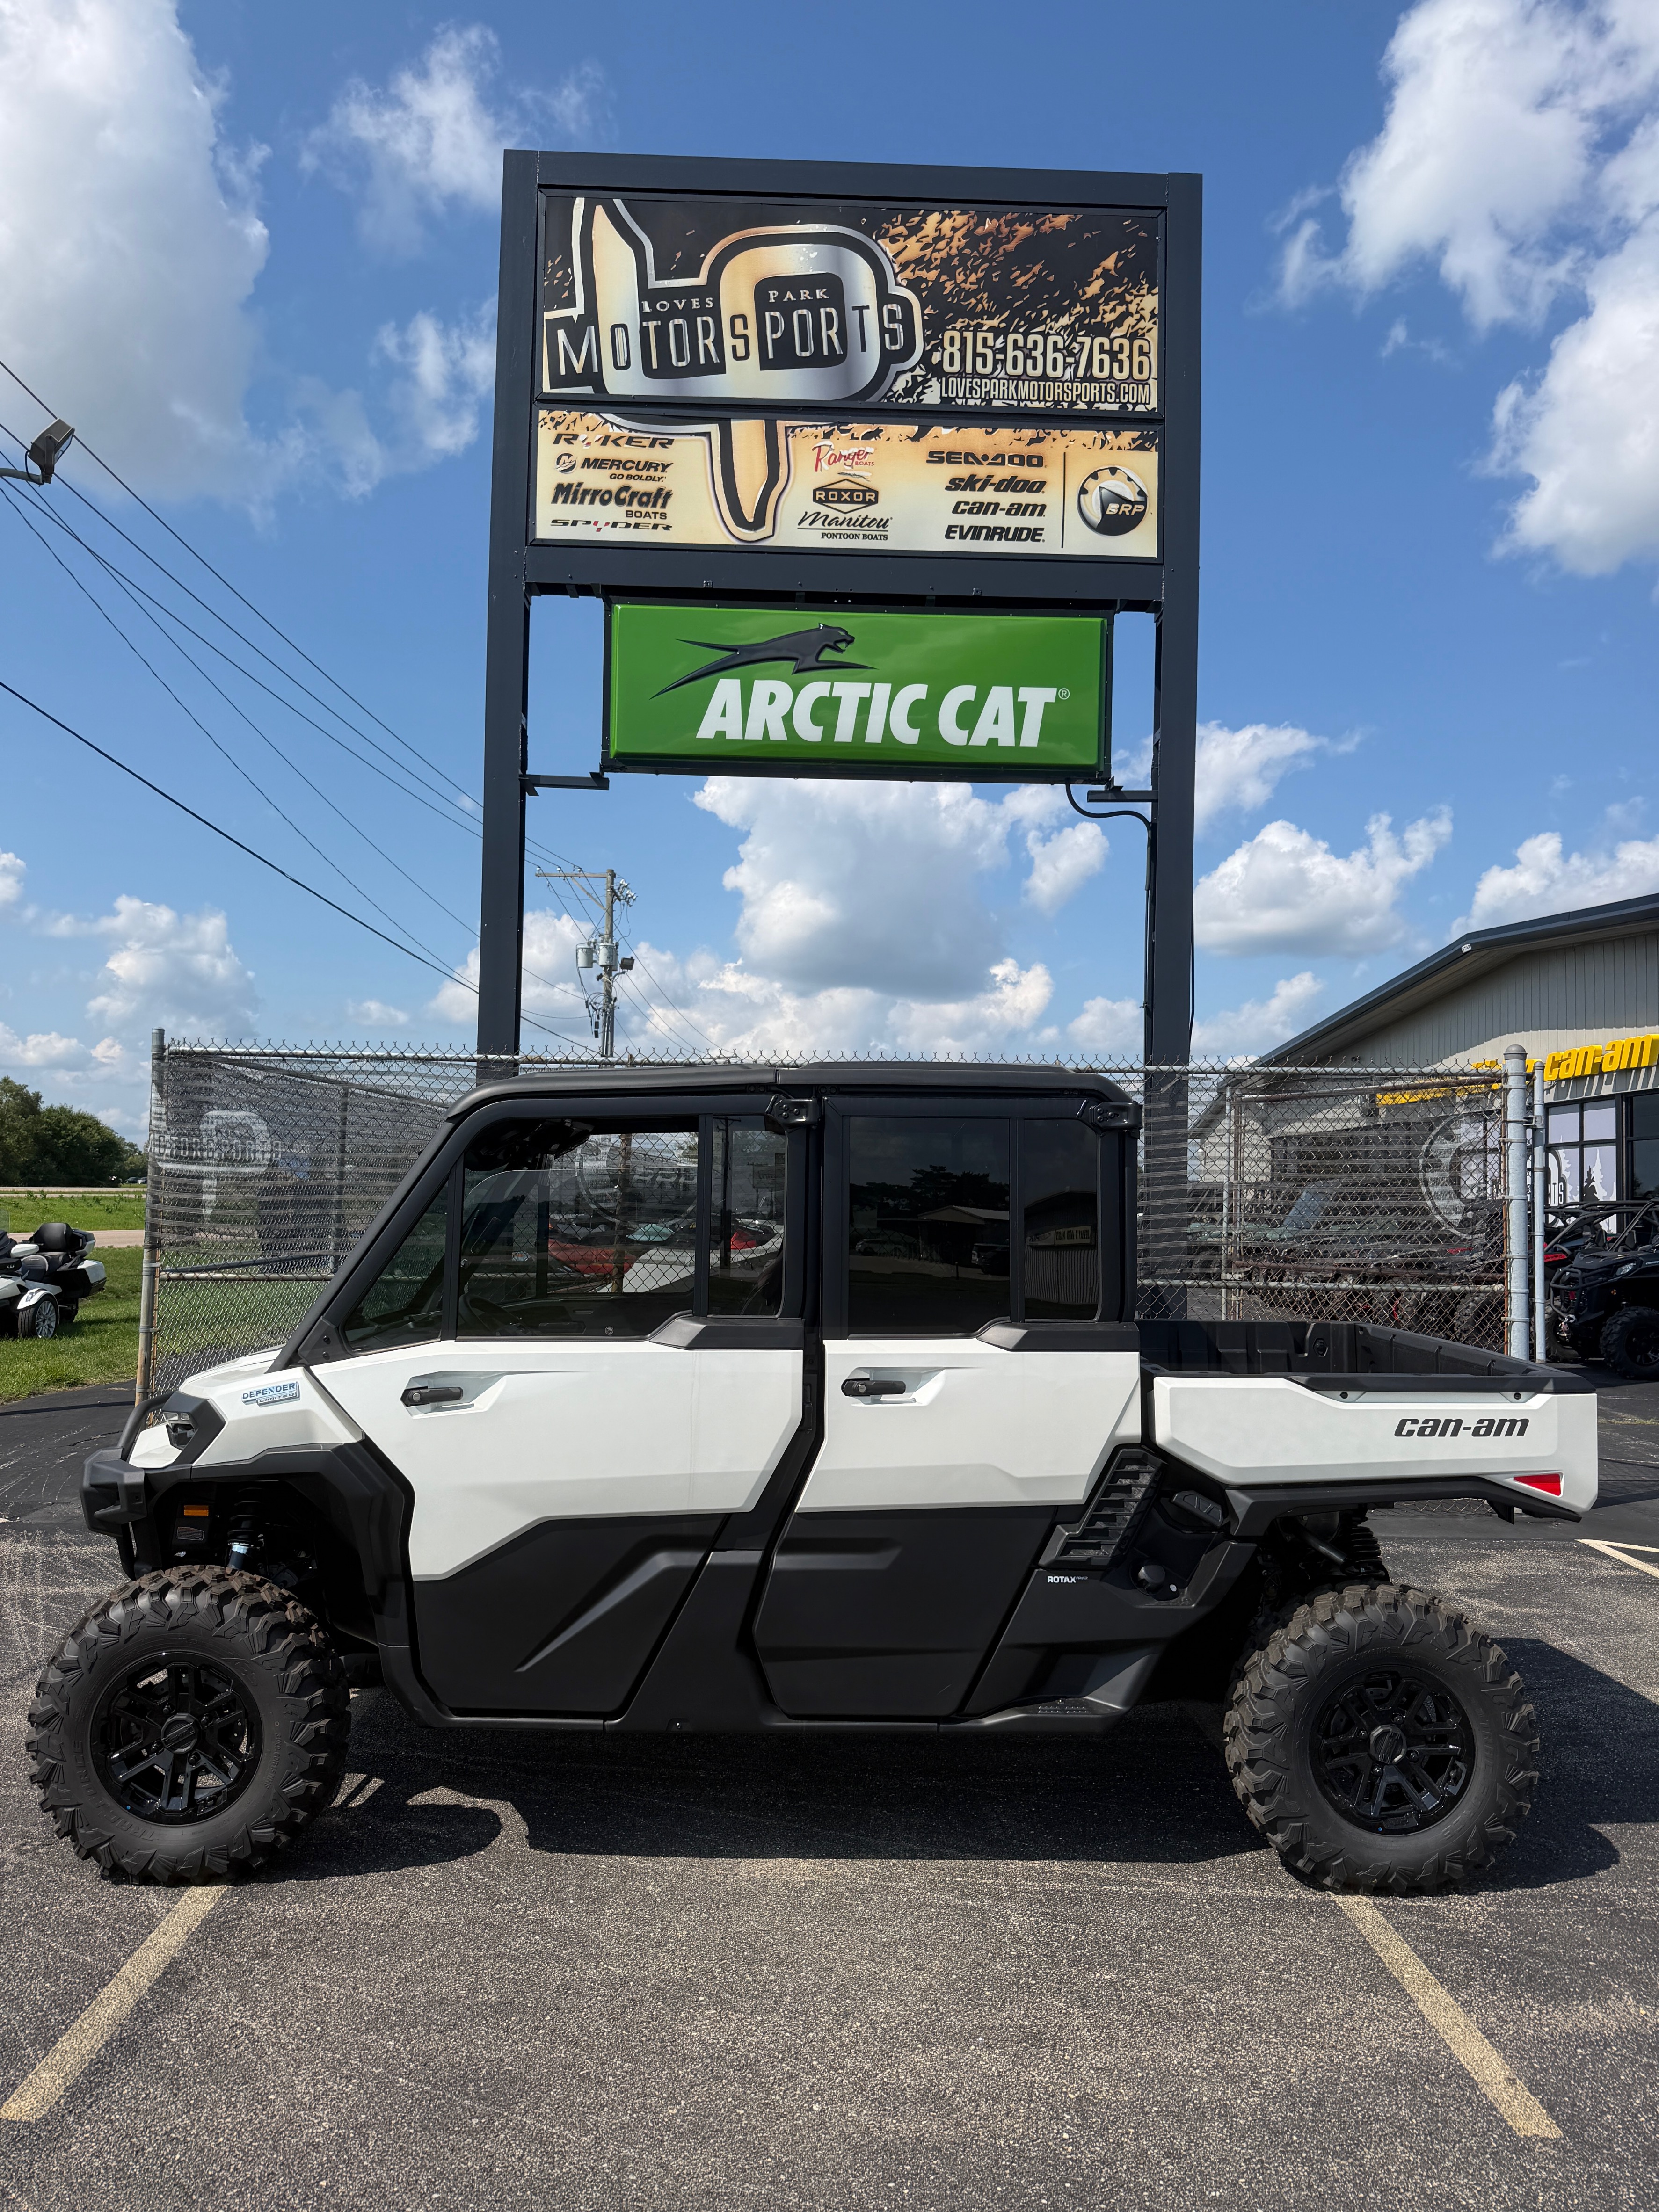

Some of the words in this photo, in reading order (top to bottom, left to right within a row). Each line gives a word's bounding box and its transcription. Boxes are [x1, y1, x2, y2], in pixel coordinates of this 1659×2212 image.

[642, 297, 714, 313] LOVES
[768, 288, 829, 302] PARK
[557, 303, 902, 375] MOTORSPORTS
[943, 330, 1151, 380] 815-636-7636
[941, 377, 1150, 404] LOVESPARKMOTORSPORTS.COM
[580, 458, 674, 473] MERCURY
[812, 441, 874, 472] Ranger
[945, 474, 1047, 493] ski-doo
[551, 482, 673, 509] MirroCraft
[816, 491, 875, 502] ROXOR
[626, 510, 667, 520] BOATS
[952, 500, 1047, 517] can-am
[1105, 503, 1145, 515] BRP
[550, 518, 673, 532] SPYDER
[798, 511, 889, 529] Manitou
[945, 524, 1044, 542] EVINRUDE
[696, 678, 928, 745] ARCTIC
[242, 1383, 296, 1399] DEFENDER
[1394, 1418, 1529, 1437] can-am
